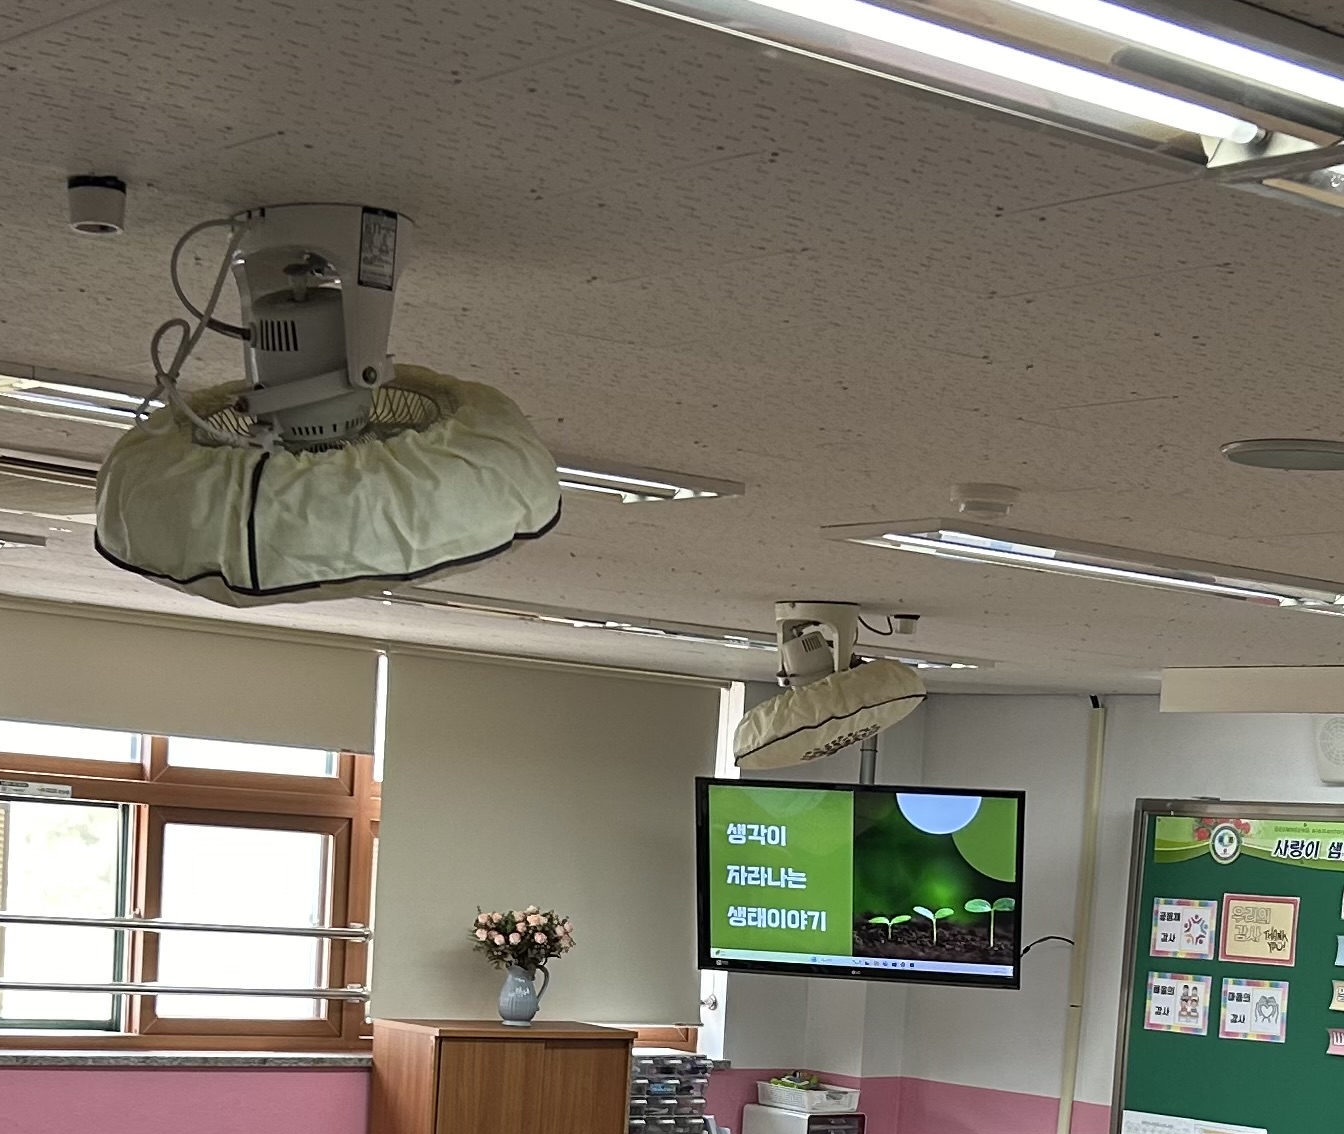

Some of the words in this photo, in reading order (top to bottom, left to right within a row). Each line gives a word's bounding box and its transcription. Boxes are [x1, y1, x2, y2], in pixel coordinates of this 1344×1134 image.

[726, 822, 787, 847] 생각이
[1273, 839, 1320, 858] 사랑이
[726, 865, 807, 890] 자라나는
[727, 905, 827, 932] 생태이야기
[1231, 905, 1271, 925] 우리의
[1234, 924, 1262, 942] 감사
